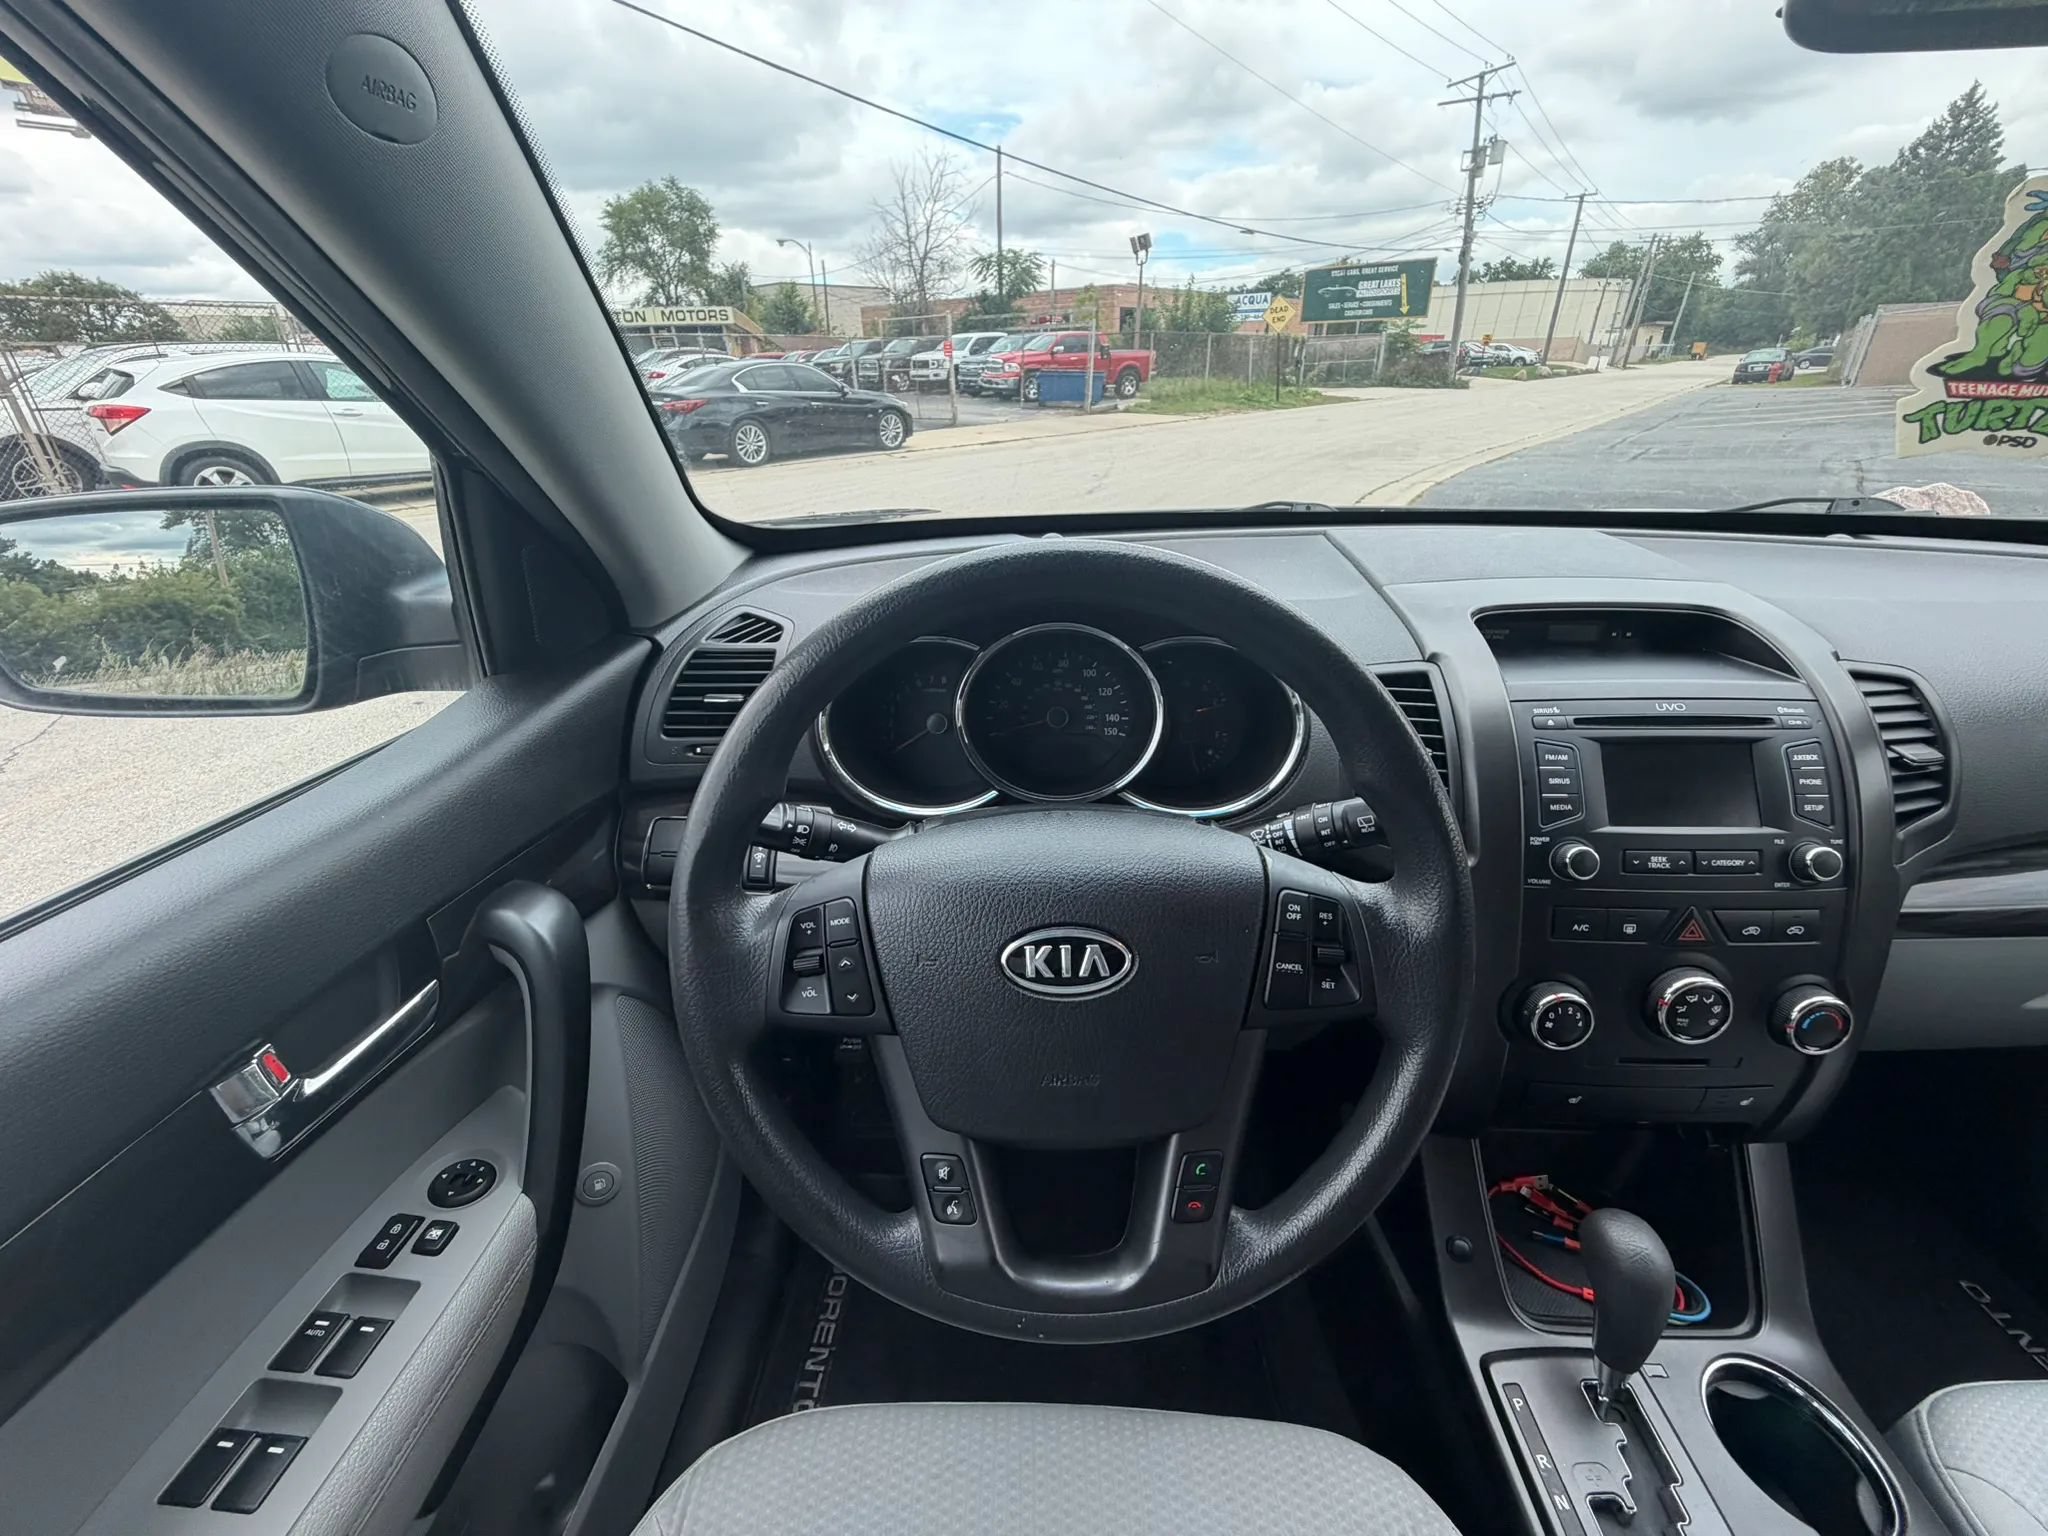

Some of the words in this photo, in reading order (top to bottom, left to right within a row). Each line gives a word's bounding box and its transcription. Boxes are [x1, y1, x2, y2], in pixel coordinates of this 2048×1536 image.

[361, 74, 416, 112] AIRBAG
[1358, 280, 1379, 289] GREAT
[1380, 279, 1400, 288] LAKES
[1270, 305, 1289, 314] DEAD
[661, 309, 729, 321] MOTORS
[1948, 382, 2016, 396] TEENAGE
[1083, 669, 1097, 677] 100
[1099, 688, 1112, 696] 120
[1655, 702, 1686, 711] UVO
[1105, 714, 1120, 722] 140
[1104, 728, 1118, 736] 150
[1548, 777, 1571, 785] SIRIUS
[1550, 803, 1573, 811] MEDIA
[1272, 830, 1283, 838] OFF
[1711, 859, 1745, 867] CATEGORY
[1287, 903, 1301, 911] ON
[1286, 912, 1302, 920] OFF
[1319, 912, 1333, 920] RES
[800, 921, 816, 929] VOL
[829, 917, 851, 927] MODE
[1572, 923, 1590, 932] A/C
[1023, 944, 1111, 978] KIA
[1275, 961, 1304, 972] CANCEL
[1321, 981, 1336, 989] SET
[801, 989, 818, 998] VOL
[1558, 1007, 1562, 1015] 1
[1567, 1006, 1573, 1014] 2
[304, 1328, 325, 1337] AUTO
[792, 1267, 848, 1413] ORENTO
[1512, 1397, 1523, 1412] P
[1535, 1454, 1551, 1469] R
[1553, 1494, 1571, 1511] N
